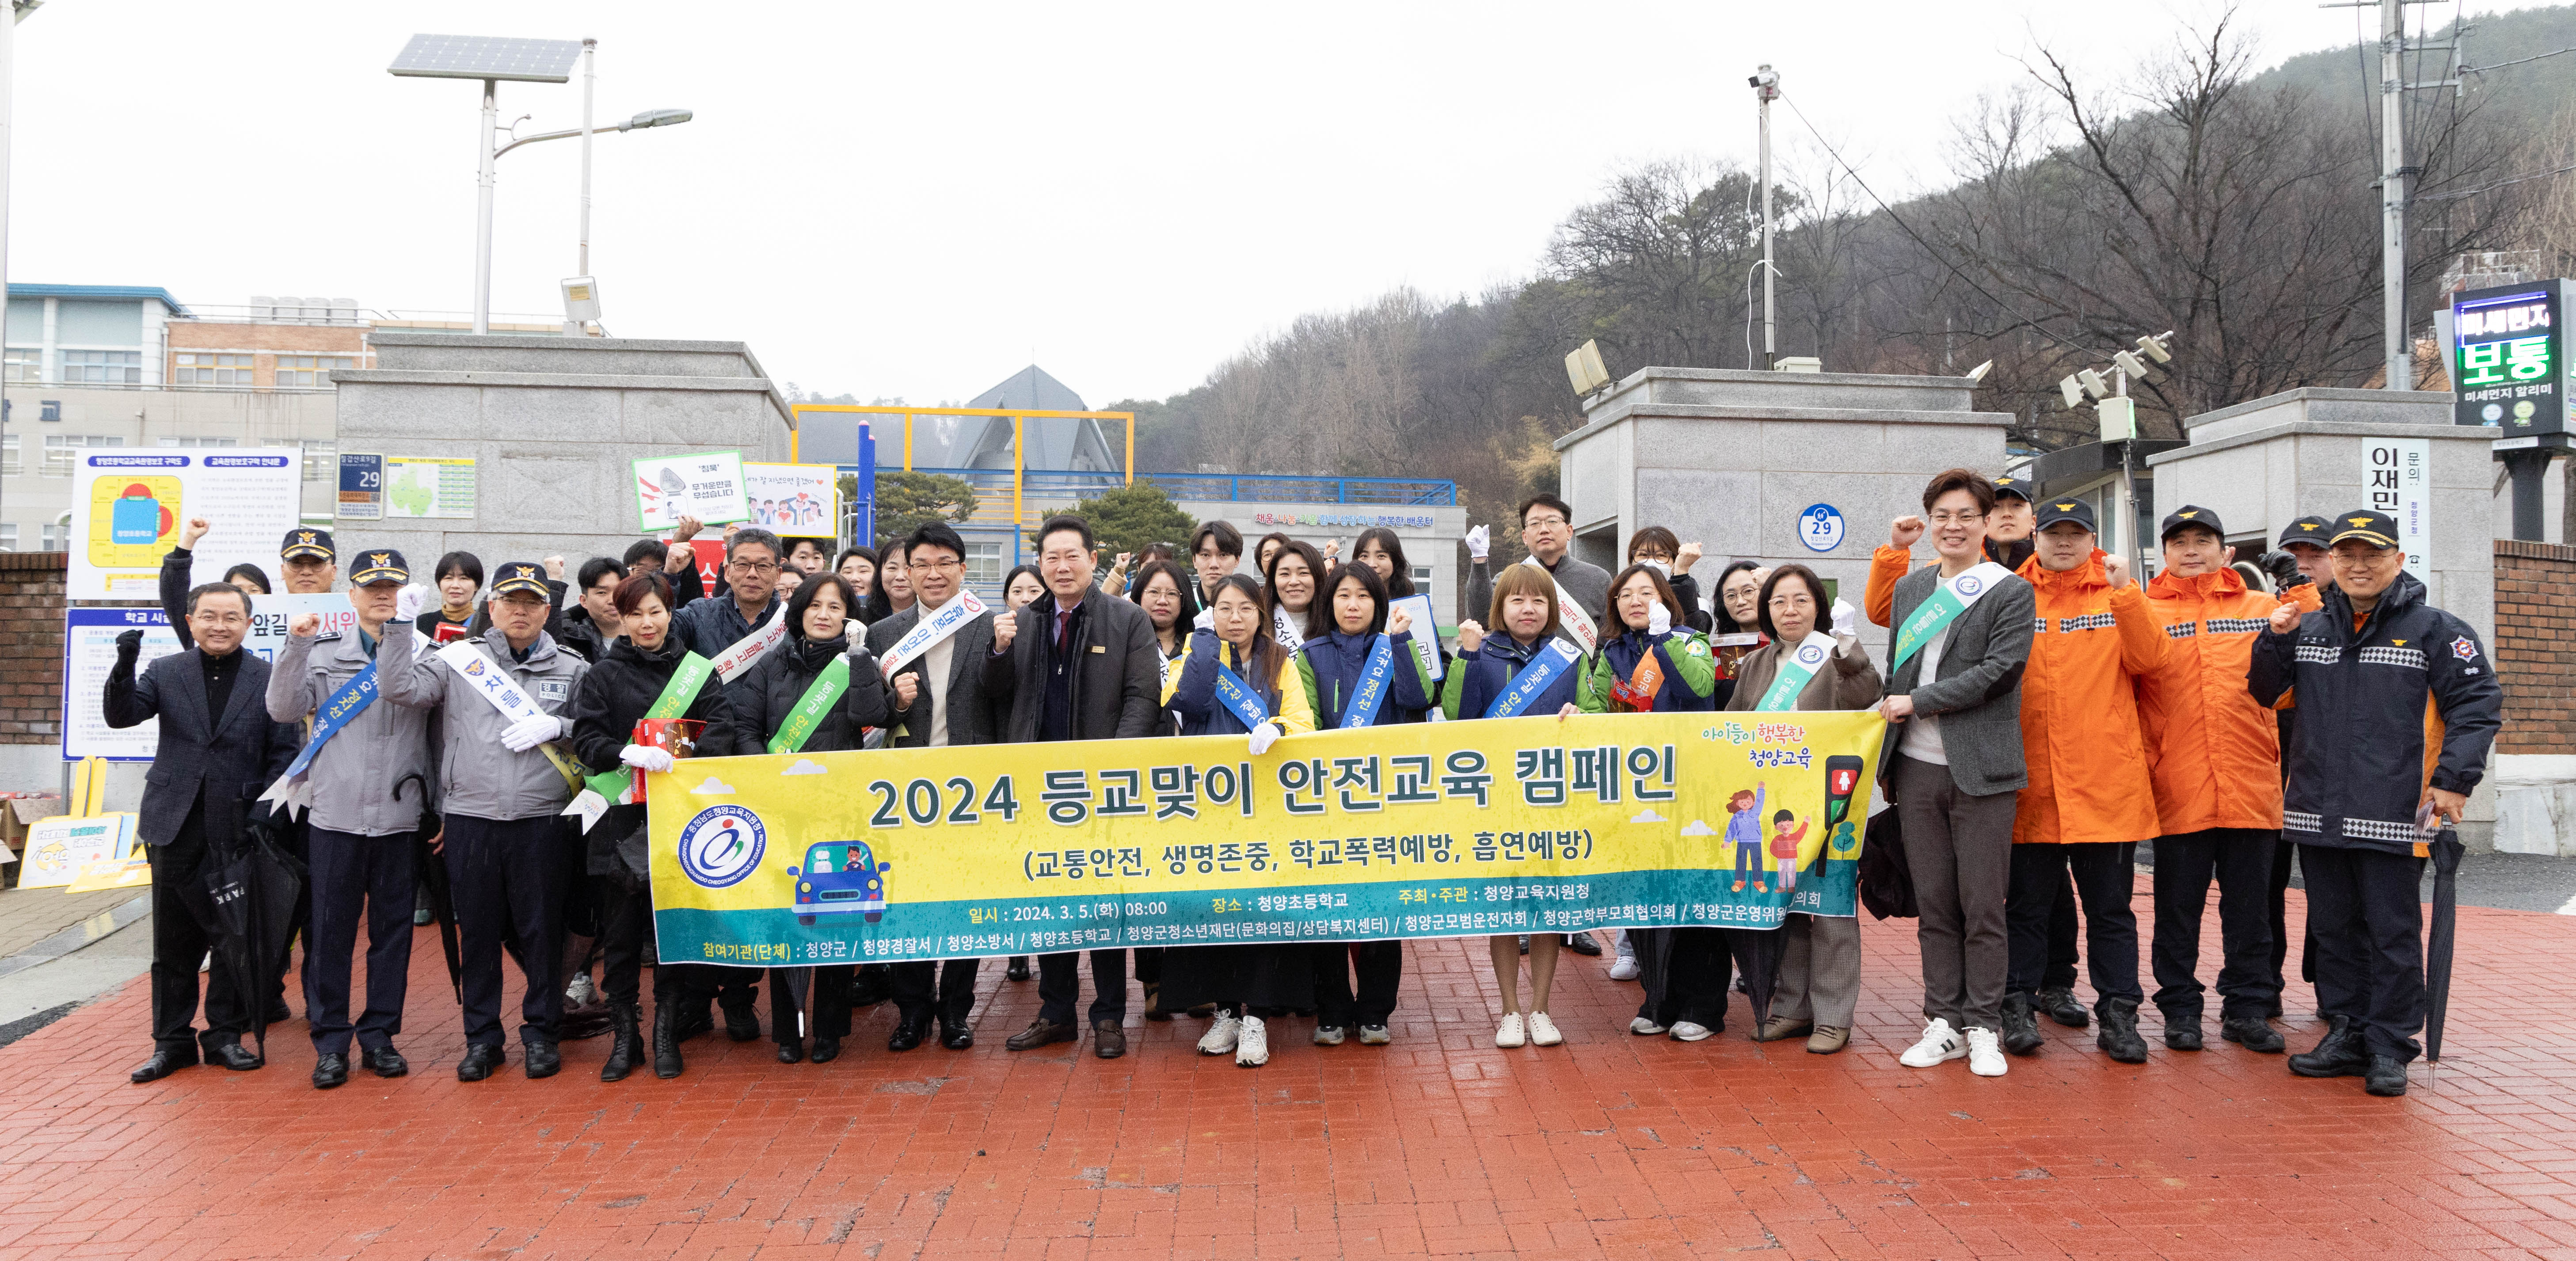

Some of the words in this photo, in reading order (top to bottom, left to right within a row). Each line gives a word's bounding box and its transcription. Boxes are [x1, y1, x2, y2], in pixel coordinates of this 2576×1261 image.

[2462, 305, 2549, 335] 미세먼지
[2464, 338, 2549, 384] 보통
[2465, 388, 2513, 402] 미세먼지
[2515, 383, 2553, 397] 알리미
[360, 471, 380, 488] 29
[692, 480, 732, 491] 무거운만큼
[693, 489, 734, 499] 무섭습니다
[1319, 514, 1338, 526] 함께
[1339, 515, 1376, 527] 성장하는
[1377, 516, 1404, 527] 행복한
[1407, 516, 1434, 527] 배움터
[1812, 522, 1831, 534] 29
[126, 612, 147, 623] 학교
[253, 613, 288, 636] 앞길
[931, 604, 965, 636] 휴대폰,
[735, 640, 765, 667] 살피고,
[897, 628, 931, 657] 이어폰
[1371, 646, 1393, 678] 지켜요
[485, 674, 522, 708] 차를
[676, 665, 700, 697] 등굣길
[1520, 663, 1551, 695] 등굣길
[329, 688, 361, 720] 정지선
[806, 680, 836, 716] 등굣길
[1358, 678, 1380, 711] 정지선
[1702, 721, 1756, 745] 아이들이
[1757, 722, 1805, 744] 행복한
[1749, 748, 1813, 770] 청양교육
[868, 774, 1020, 827] 2024
[1040, 761, 1255, 826] 등교맞이
[1278, 750, 1493, 816] 안전교육
[1515, 744, 1677, 807] 캠페인
[688, 807, 762, 834] 충청남도청양교육지원청
[682, 838, 708, 883] CHUNGCHEONGNAMDO
[708, 874, 737, 885] CHEOGYANG
[737, 864, 751, 877] OFFICE
[753, 834, 764, 861] EDUCATION
[1024, 846, 1152, 882] (교통안전,
[1161, 842, 1279, 876] 생명존중,
[1289, 833, 1461, 869] 학교폭력예방,
[1472, 829, 1593, 862] 흡연예방)
[1212, 898, 1242, 913] 장소
[1257, 893, 1349, 912] 청양초등학교
[1484, 883, 1590, 902] 청양교육지원청
[703, 941, 791, 961] 참여기관(단체)
[805, 941, 847, 958] 청양군
[863, 936, 931, 956] 청양경찰서
[947, 932, 1014, 952] 청양소방서
[1030, 929, 1111, 948] 청양초등학교
[1127, 916, 1389, 941] 청양군청소년재단(문화의집/상담복지센터)
[1405, 909, 1527, 932] 청양군모범운전자회
[1543, 903, 1676, 926] 청양군학부모회협의회
[1692, 891, 1821, 922] 청양군운영위원의회
[969, 907, 998, 924] 일시
[1013, 907, 1055, 922] 2024.
[1060, 906, 1074, 921] 3.
[1079, 902, 1119, 921] 5.(화)
[1125, 901, 1167, 916] 08:00
